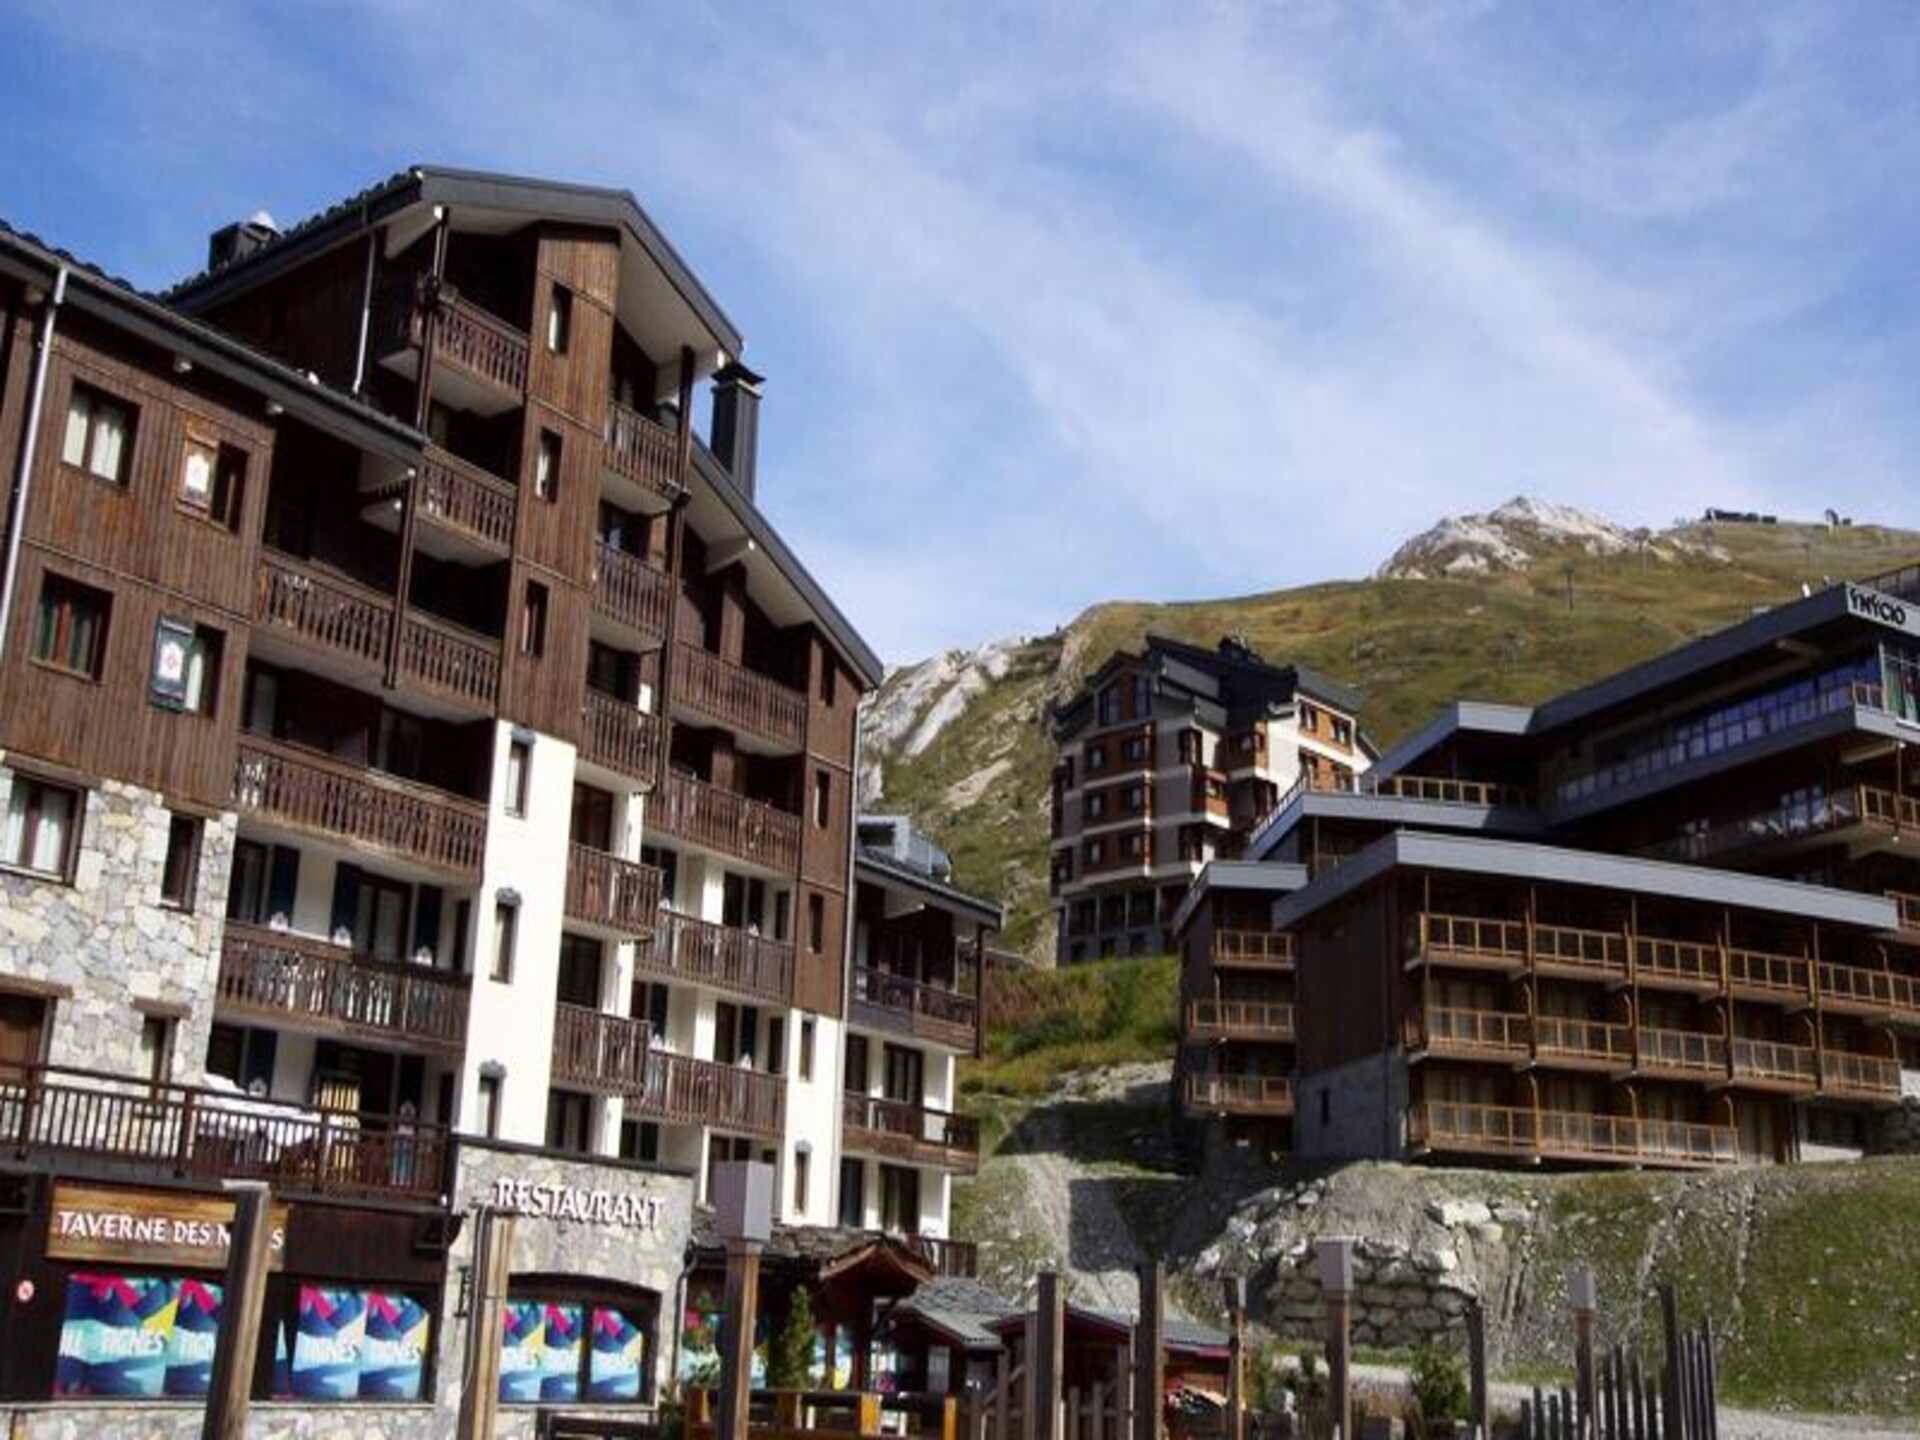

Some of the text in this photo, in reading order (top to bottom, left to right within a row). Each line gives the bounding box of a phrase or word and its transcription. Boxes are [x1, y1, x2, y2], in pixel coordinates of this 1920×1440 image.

[495, 1175, 667, 1227] RESTAURANT
[58, 1210, 167, 1242] TAVERNE
[172, 1221, 211, 1246] DES
